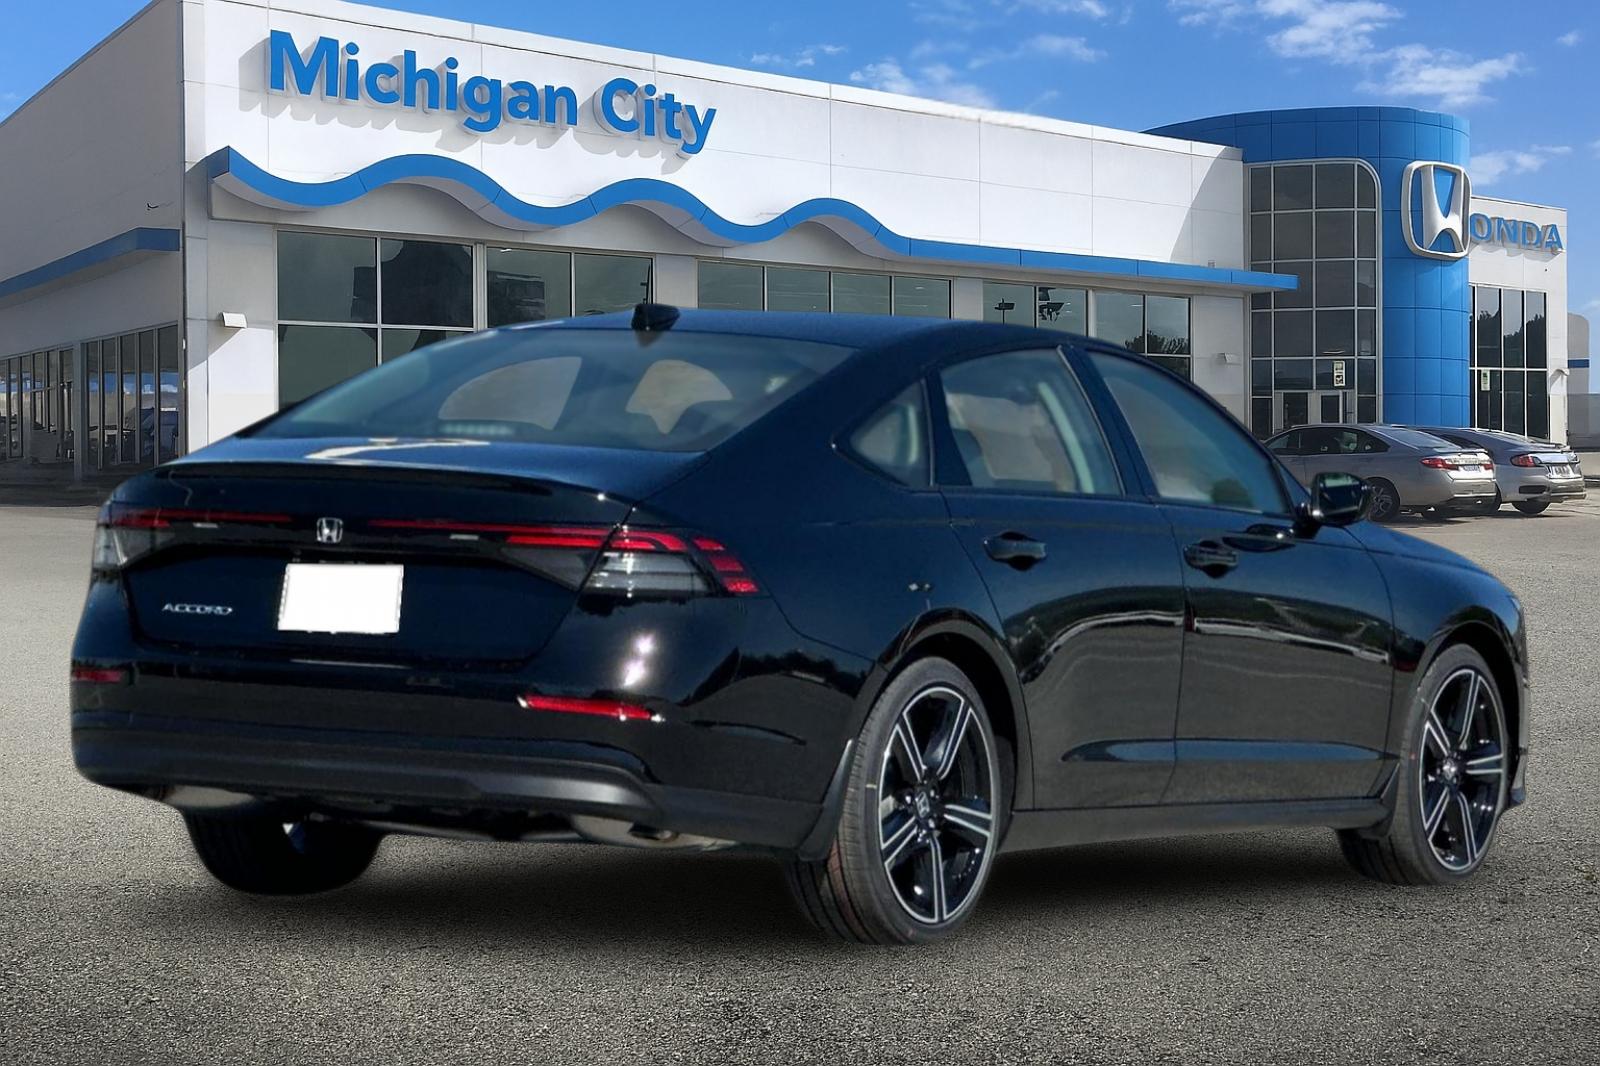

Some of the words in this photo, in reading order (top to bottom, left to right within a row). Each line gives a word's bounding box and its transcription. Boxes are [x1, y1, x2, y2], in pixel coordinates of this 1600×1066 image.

[270, 29, 578, 133] Michigan
[601, 77, 717, 155] City
[1469, 212, 1563, 249] ONDA
[162, 603, 233, 616] ACCORD
